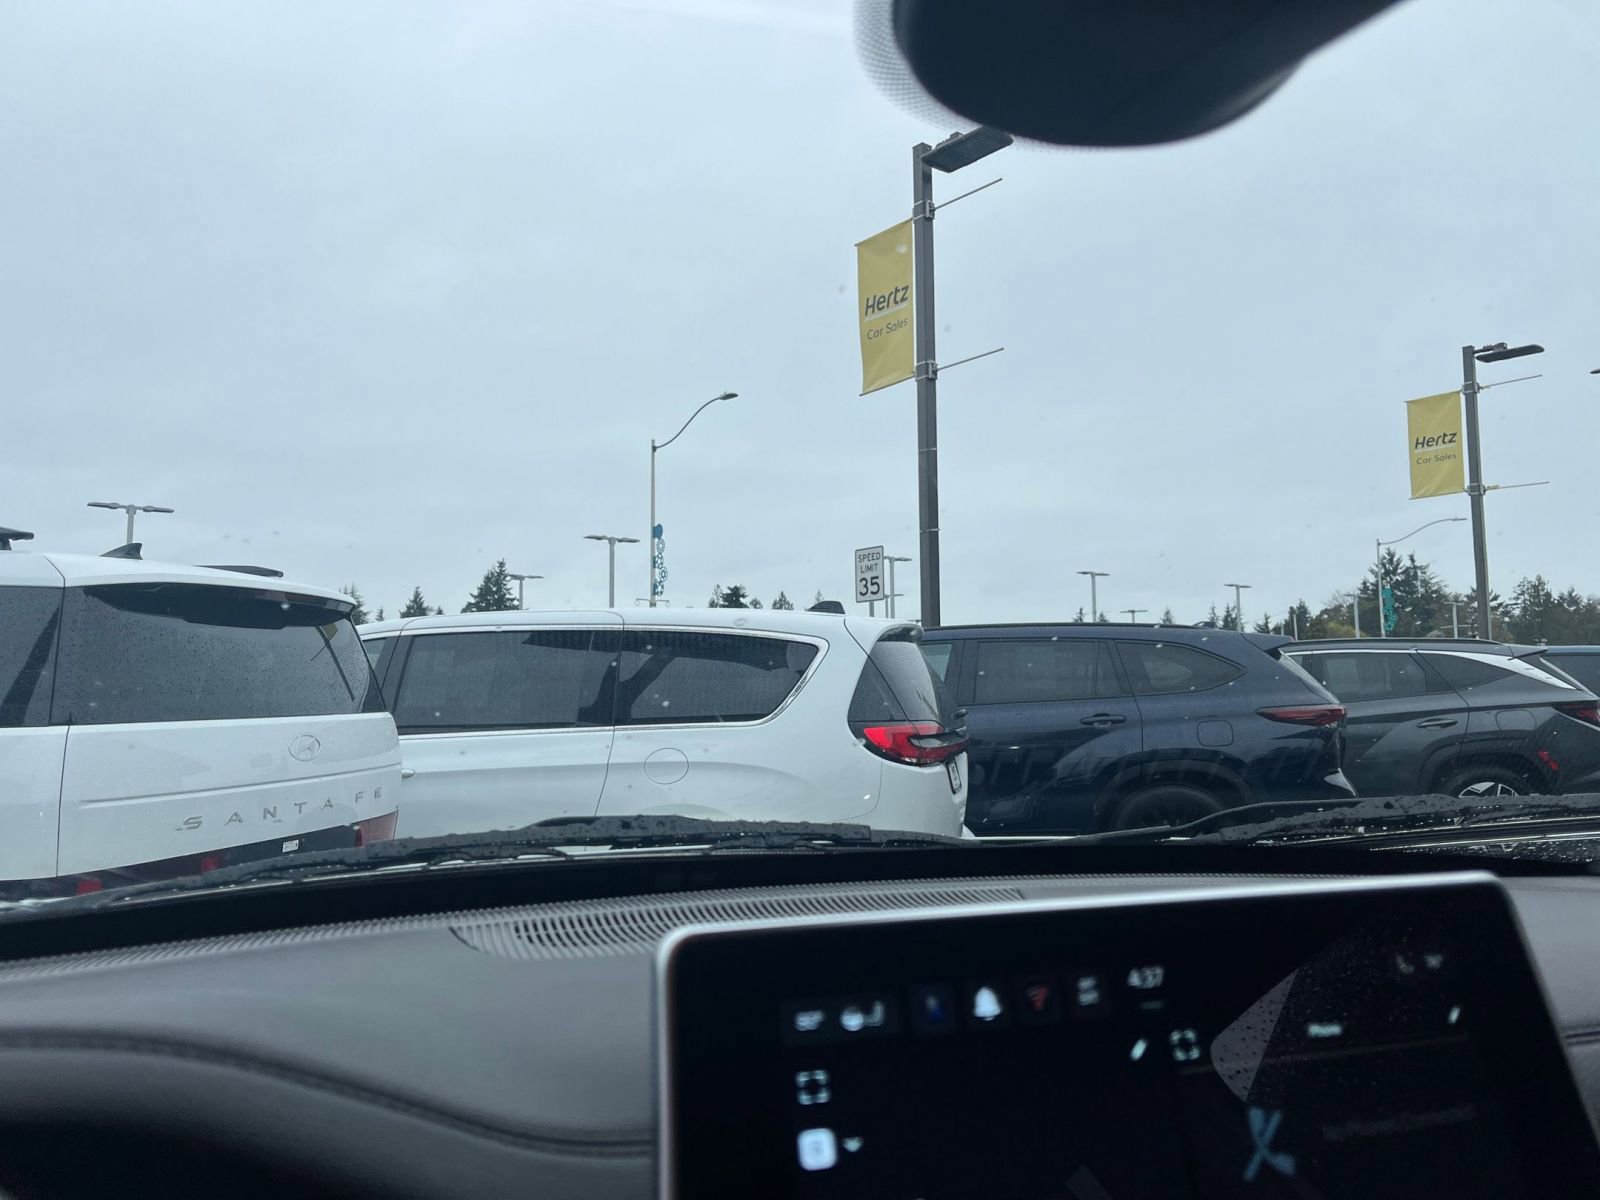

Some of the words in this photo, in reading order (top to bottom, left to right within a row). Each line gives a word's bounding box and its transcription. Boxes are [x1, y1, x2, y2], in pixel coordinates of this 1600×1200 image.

[865, 285, 909, 317] Hertz
[867, 328, 884, 340] Car
[886, 318, 908, 334] Sales
[1414, 432, 1457, 449] Hertz
[1416, 456, 1432, 465] Car
[1434, 453, 1456, 463] Sales
[858, 552, 881, 563] SPEED
[860, 563, 878, 574] LIMIT
[859, 576, 880, 596] 35
[183, 798, 333, 830] SANTA
[354, 786, 383, 803] FE
